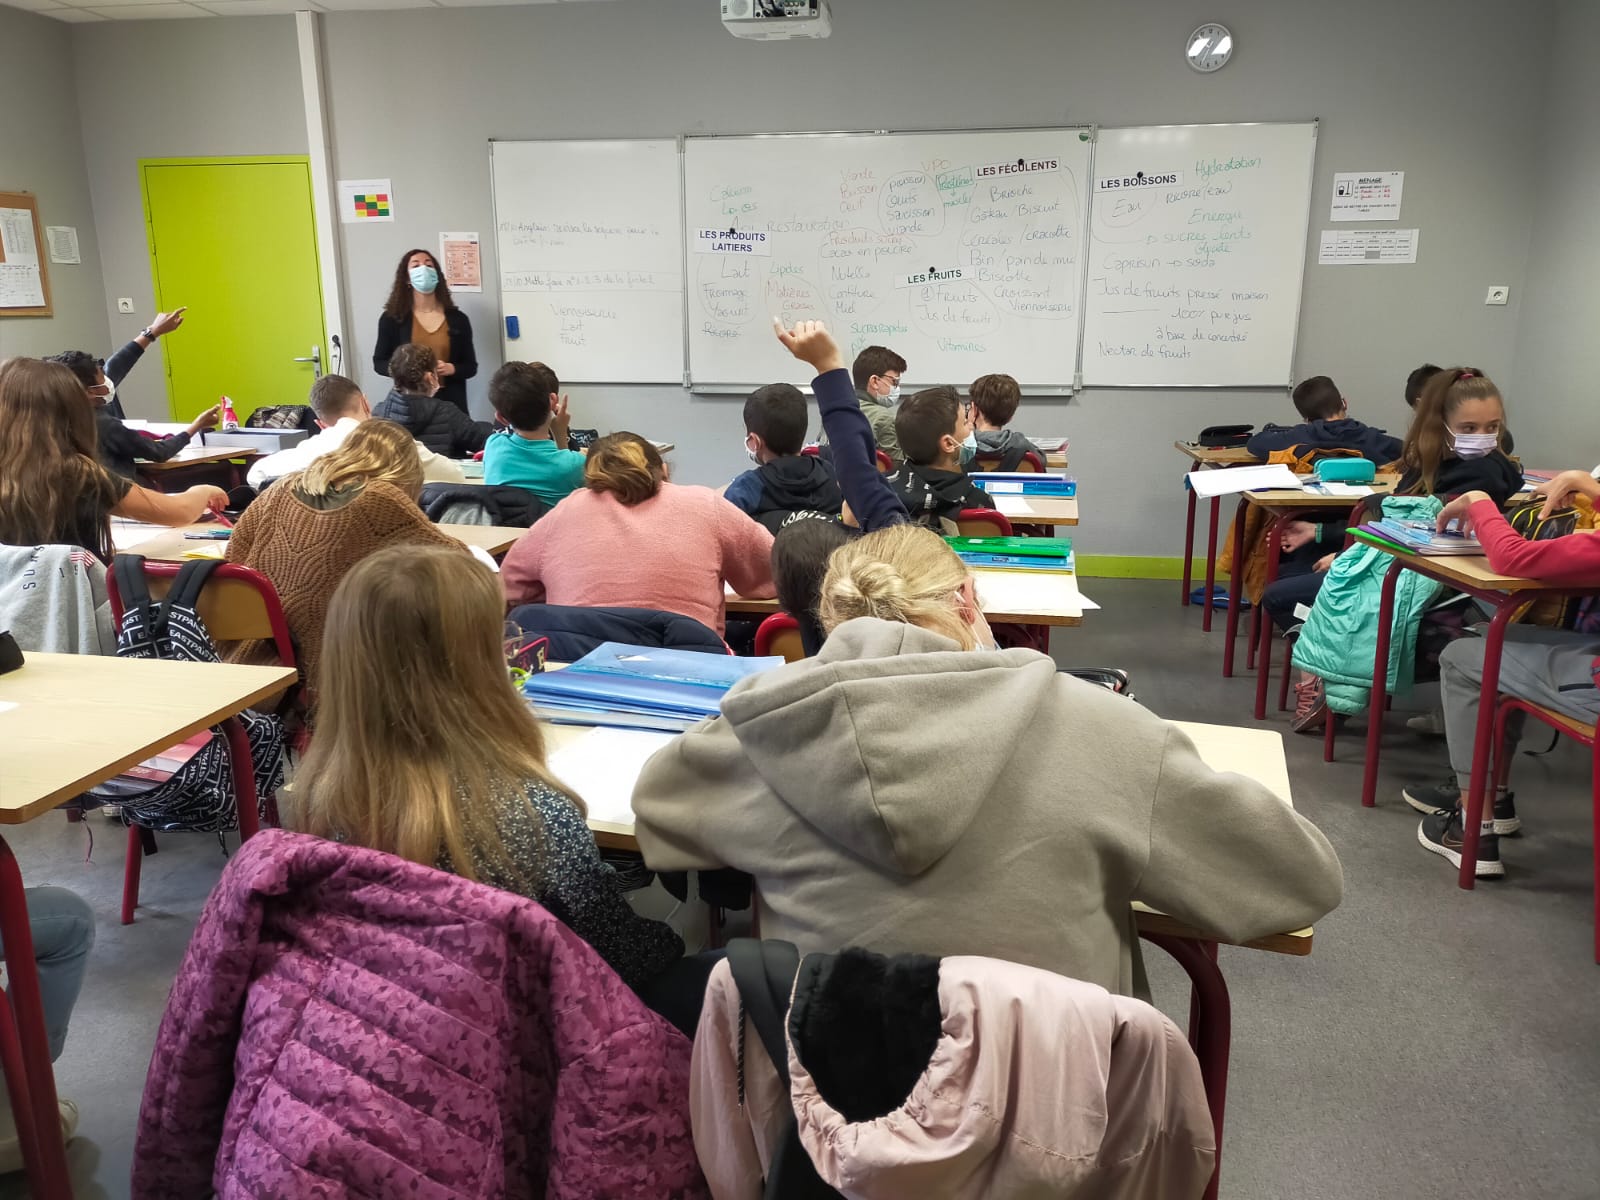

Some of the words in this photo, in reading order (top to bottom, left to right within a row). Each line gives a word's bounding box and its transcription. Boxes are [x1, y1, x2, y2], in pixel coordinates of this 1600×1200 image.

[977, 167, 996, 177] LES
[999, 160, 1058, 175] FÉCULENTS
[1101, 179, 1121, 189] LES
[1123, 174, 1177, 187] BOISSONS
[1112, 198, 1143, 217] Eau
[700, 230, 717, 239] LES
[720, 232, 766, 242] PRODUITS
[712, 242, 753, 252] LAITIERS
[907, 274, 926, 284] LES
[928, 269, 963, 281] FRUITS
[1123, 280, 1142, 296] de
[1141, 344, 1154, 357] de
